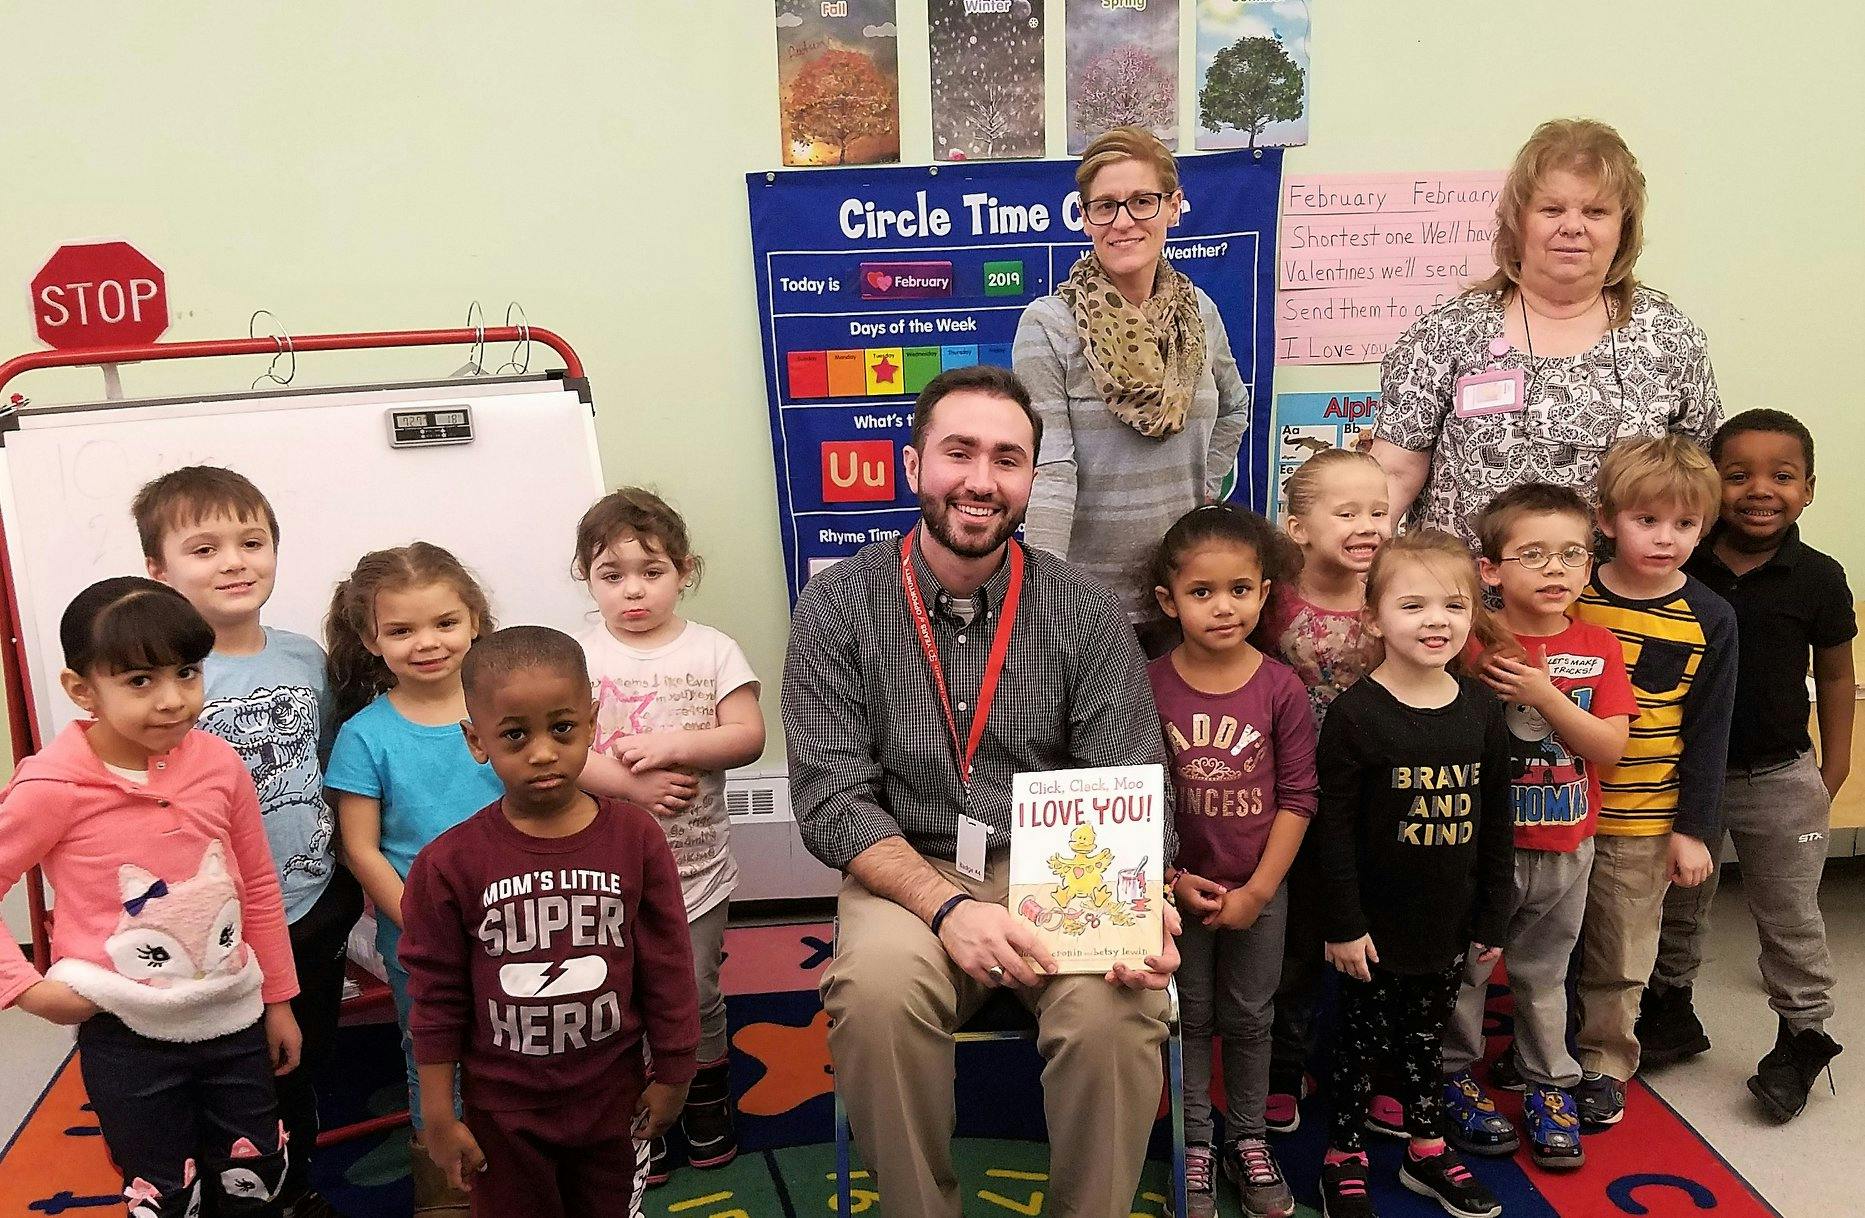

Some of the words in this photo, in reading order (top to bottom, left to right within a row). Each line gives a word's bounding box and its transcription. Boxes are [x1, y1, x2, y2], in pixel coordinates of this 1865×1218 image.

[821, 1, 848, 17] Fall
[964, 0, 1012, 15] Winter
[1290, 185, 1387, 211] February
[1413, 181, 1499, 207] February
[839, 190, 952, 239] Circle
[962, 193, 1050, 236] Time
[1290, 224, 1380, 249] Shortest
[1385, 232, 1415, 245] one
[1467, 220, 1497, 242] hav
[1162, 242, 1228, 260] Weather?
[988, 272, 1020, 287] 2019
[1286, 259, 1375, 282] Valentines
[1381, 256, 1415, 279] we'll
[1425, 256, 1468, 278] send
[780, 277, 825, 294] Today
[828, 277, 840, 292] is
[894, 276, 949, 290] February
[40, 278, 159, 328] STOP
[1282, 298, 1333, 320] Send
[1339, 298, 1381, 319] them
[1387, 297, 1408, 318] to
[850, 321, 886, 338] Days
[889, 319, 905, 333] of
[909, 319, 933, 332] the
[937, 317, 977, 331] Week
[1280, 336, 1300, 360] I
[1309, 337, 1355, 358] Love
[1323, 396, 1379, 422] Alph
[854, 414, 903, 429] What's
[1282, 425, 1300, 435] Aa
[1344, 423, 1360, 434] Bb
[829, 451, 885, 487] Uu
[1280, 465, 1294, 475] Ee
[819, 529, 865, 544] Rhyme
[868, 528, 901, 542] Time
[1164, 713, 1268, 773] ADDY'S
[1029, 779, 1065, 795] Click,
[1070, 778, 1109, 793] Clack,
[1114, 777, 1144, 790] Moo
[1391, 762, 1481, 790] BRAVE
[1019, 803, 1025, 827] I
[1031, 799, 1085, 827] LOVE
[1092, 795, 1153, 825] YOU!
[1177, 787, 1263, 817] INCESS
[1407, 793, 1472, 818] AND
[1510, 781, 1589, 826] HOMAS
[1397, 820, 1473, 846] KIND
[1798, 832, 1823, 843] STX
[482, 870, 554, 908] MOM'S
[560, 869, 622, 895] LITTLE
[478, 894, 625, 957] SUPER
[1122, 946, 1148, 956] lewin
[488, 990, 621, 1057] HERO
